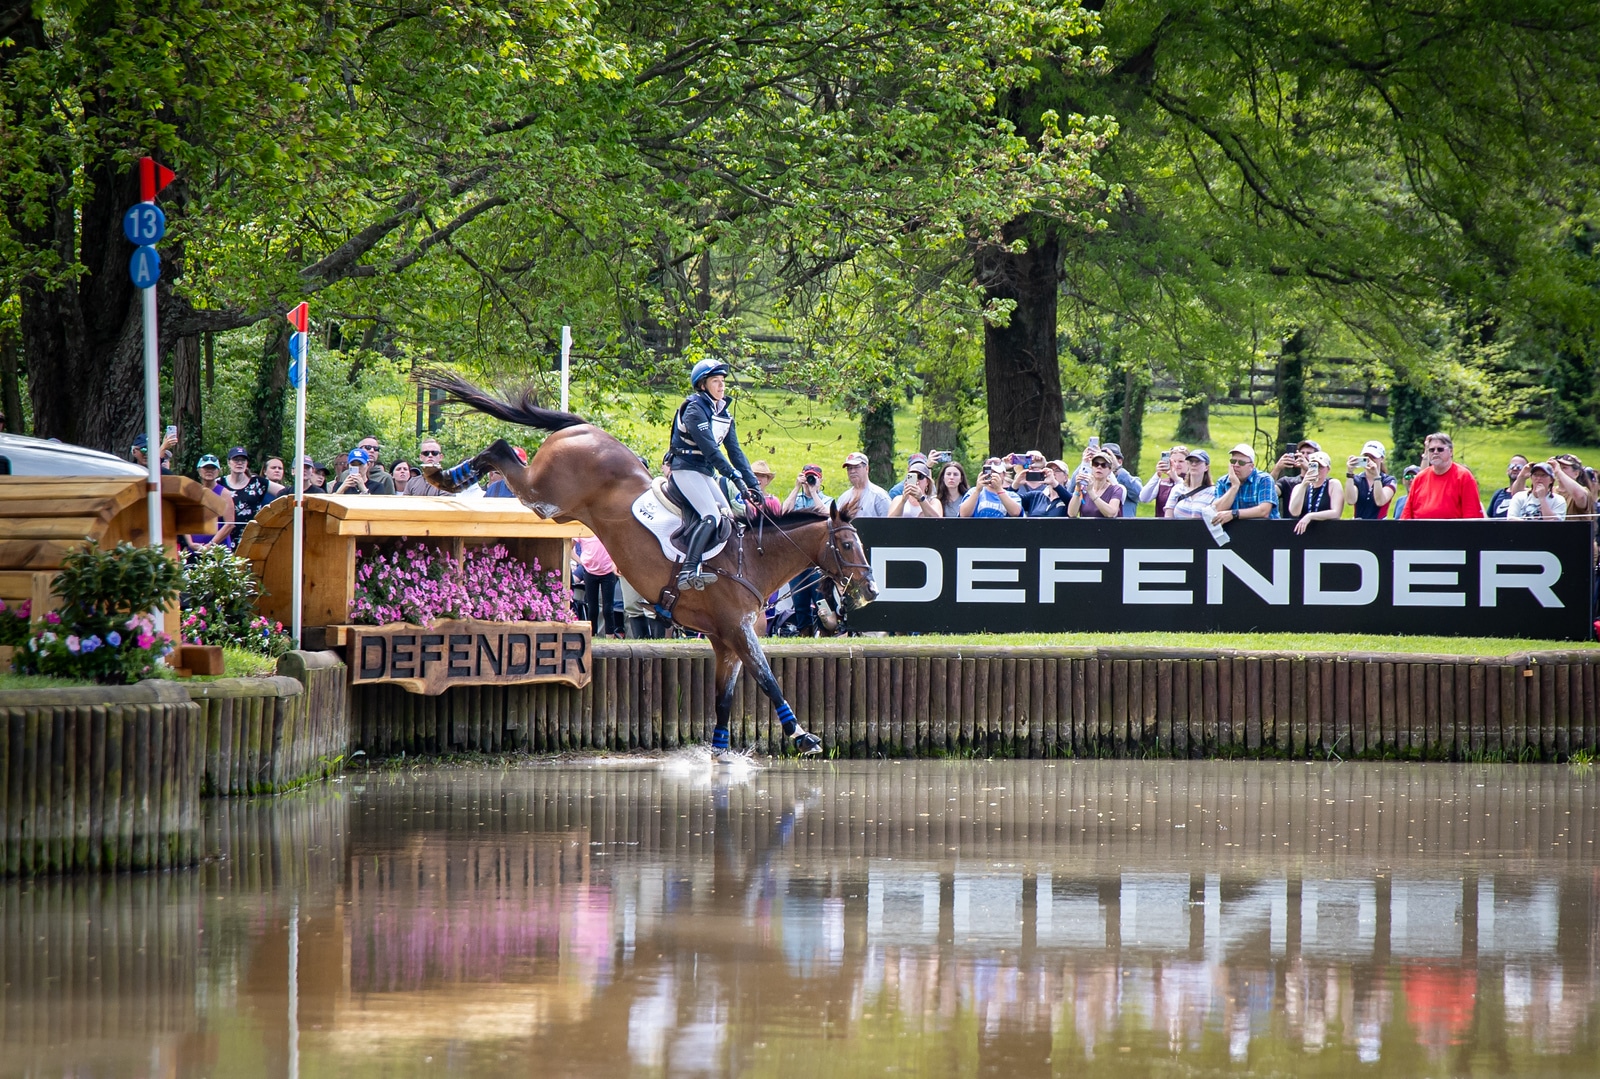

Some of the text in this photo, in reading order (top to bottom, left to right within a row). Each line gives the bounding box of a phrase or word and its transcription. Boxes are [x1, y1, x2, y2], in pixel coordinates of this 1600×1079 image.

[130, 208, 157, 239] 13
[137, 253, 150, 282] A
[870, 546, 1566, 608] DEFENDER
[359, 632, 587, 679] DEFENDER
